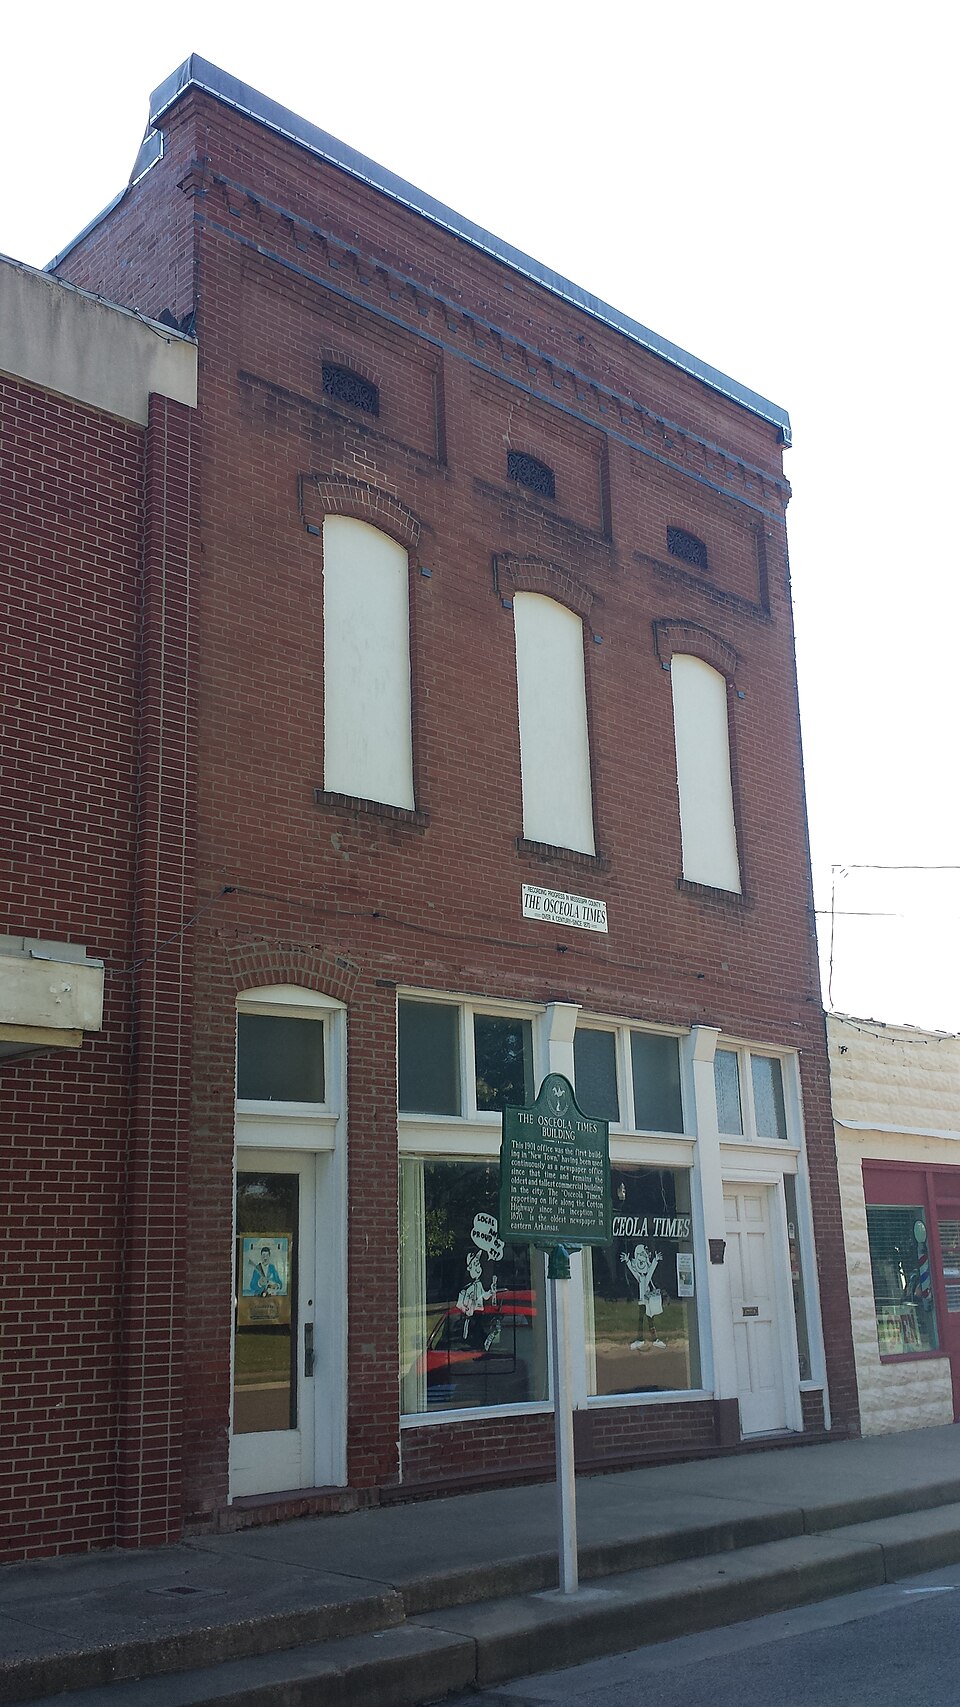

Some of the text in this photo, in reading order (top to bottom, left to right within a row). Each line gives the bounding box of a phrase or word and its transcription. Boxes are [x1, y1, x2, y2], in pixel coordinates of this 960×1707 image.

[528, 886, 547, 896] RECORDING
[548, 891, 565, 900] PROGRESS
[524, 894, 606, 924] THE OSCEOLA TIMES
[518, 1113, 598, 1133] THE OSCEOLA TIMES
[542, 1127, 575, 1140] BUILDING
[511, 1140, 523, 1148] This
[537, 1144, 553, 1153] office
[565, 1147, 573, 1155] the
[575, 1148, 586, 1156] first
[511, 1150, 520, 1158] ing
[562, 1155, 578, 1165] having
[580, 1157, 591, 1165] been
[592, 1159, 603, 1167] used
[511, 1160, 545, 1170] continuously
[560, 1165, 586, 1174] newspaper
[589, 1166, 603, 1175] office
[529, 1169, 540, 1177] that
[544, 1171, 556, 1179] time
[595, 1176, 603, 1184] the
[511, 1177, 603, 1192] oldest and tallest commercial building
[520, 1186, 529, 1194] the
[532, 1187, 544, 1196] city.
[548, 1188, 558, 1196] The
[511, 1195, 538, 1205] reporting
[549, 1197, 558, 1205] life
[561, 1198, 574, 1208] along
[576, 1199, 584, 1207] the
[586, 1200, 603, 1209] Cotton
[511, 1203, 534, 1214] Highway
[570, 1208, 593, 1217] inception
[478, 1215, 494, 1226] LOCAL
[511, 1222, 559, 1231] eastern Arkansas.
[538, 1214, 547, 1222] the
[551, 1215, 566, 1223] oldest
[570, 1218, 595, 1226] newspaper
[613, 1217, 690, 1237] CEOLA TIMES
[473, 1230, 492, 1242] PROUD
